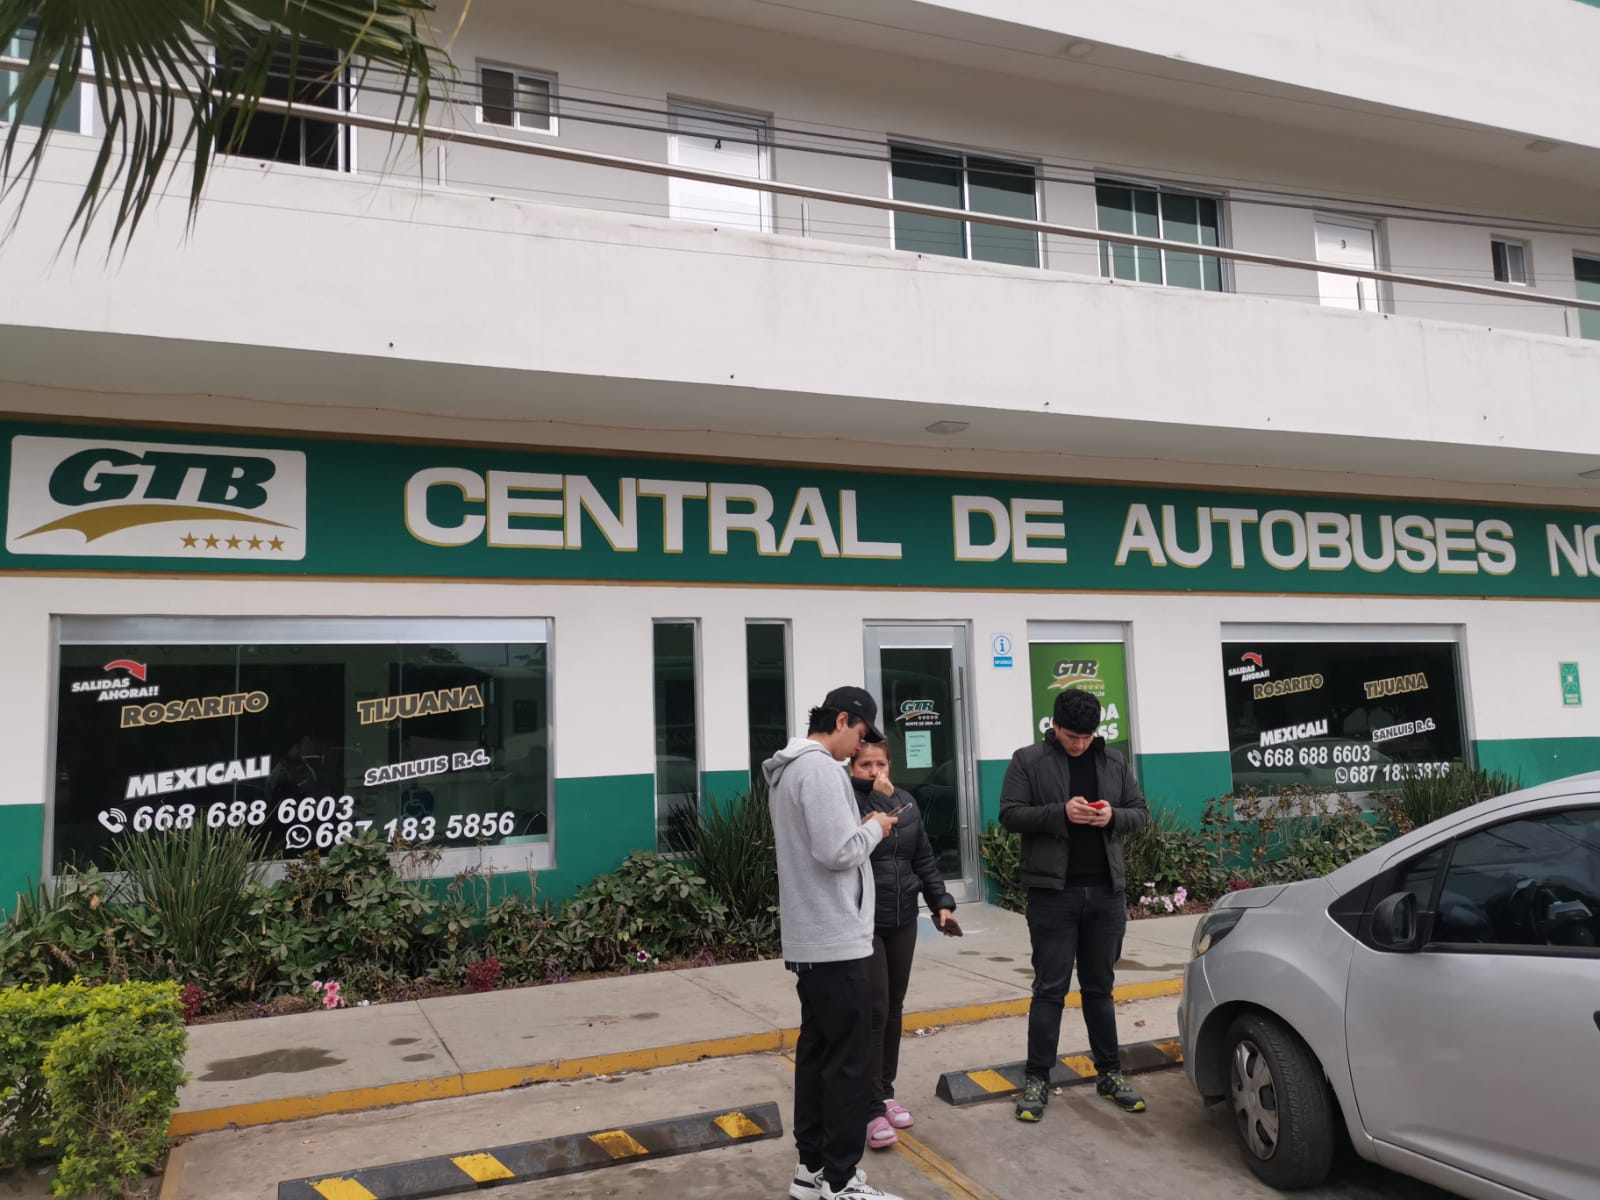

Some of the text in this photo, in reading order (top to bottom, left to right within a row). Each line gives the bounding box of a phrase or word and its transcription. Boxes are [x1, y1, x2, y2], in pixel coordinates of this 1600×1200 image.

[48, 448, 277, 510] GTB
[404, 467, 902, 560] CENTRAL
[951, 494, 1067, 564] DE
[1114, 503, 1517, 575] AUTOBUSES
[1053, 659, 1098, 678] GTB
[1228, 665, 1255, 676] SALIDAS
[71, 678, 130, 692] SALIDAS
[97, 685, 160, 701] AHORA!!
[1253, 673, 1324, 700] ROSARITO
[1364, 672, 1428, 699] TIJUANA
[120, 690, 269, 728] ROSARITO
[356, 684, 484, 725] TIJUANA
[900, 699, 935, 714] GTB
[1260, 719, 1328, 747] MEXICALI
[1372, 717, 1436, 742] SANLUIS R.C.
[363, 748, 491, 787] SANLUIS R.C.
[1264, 744, 1371, 767] 668 688 6603
[125, 755, 271, 799] MEXICALI
[1349, 764, 1378, 784] 687
[132, 795, 355, 833] 668 688 6603
[383, 815, 436, 843] 183
[445, 811, 515, 839] 5856
